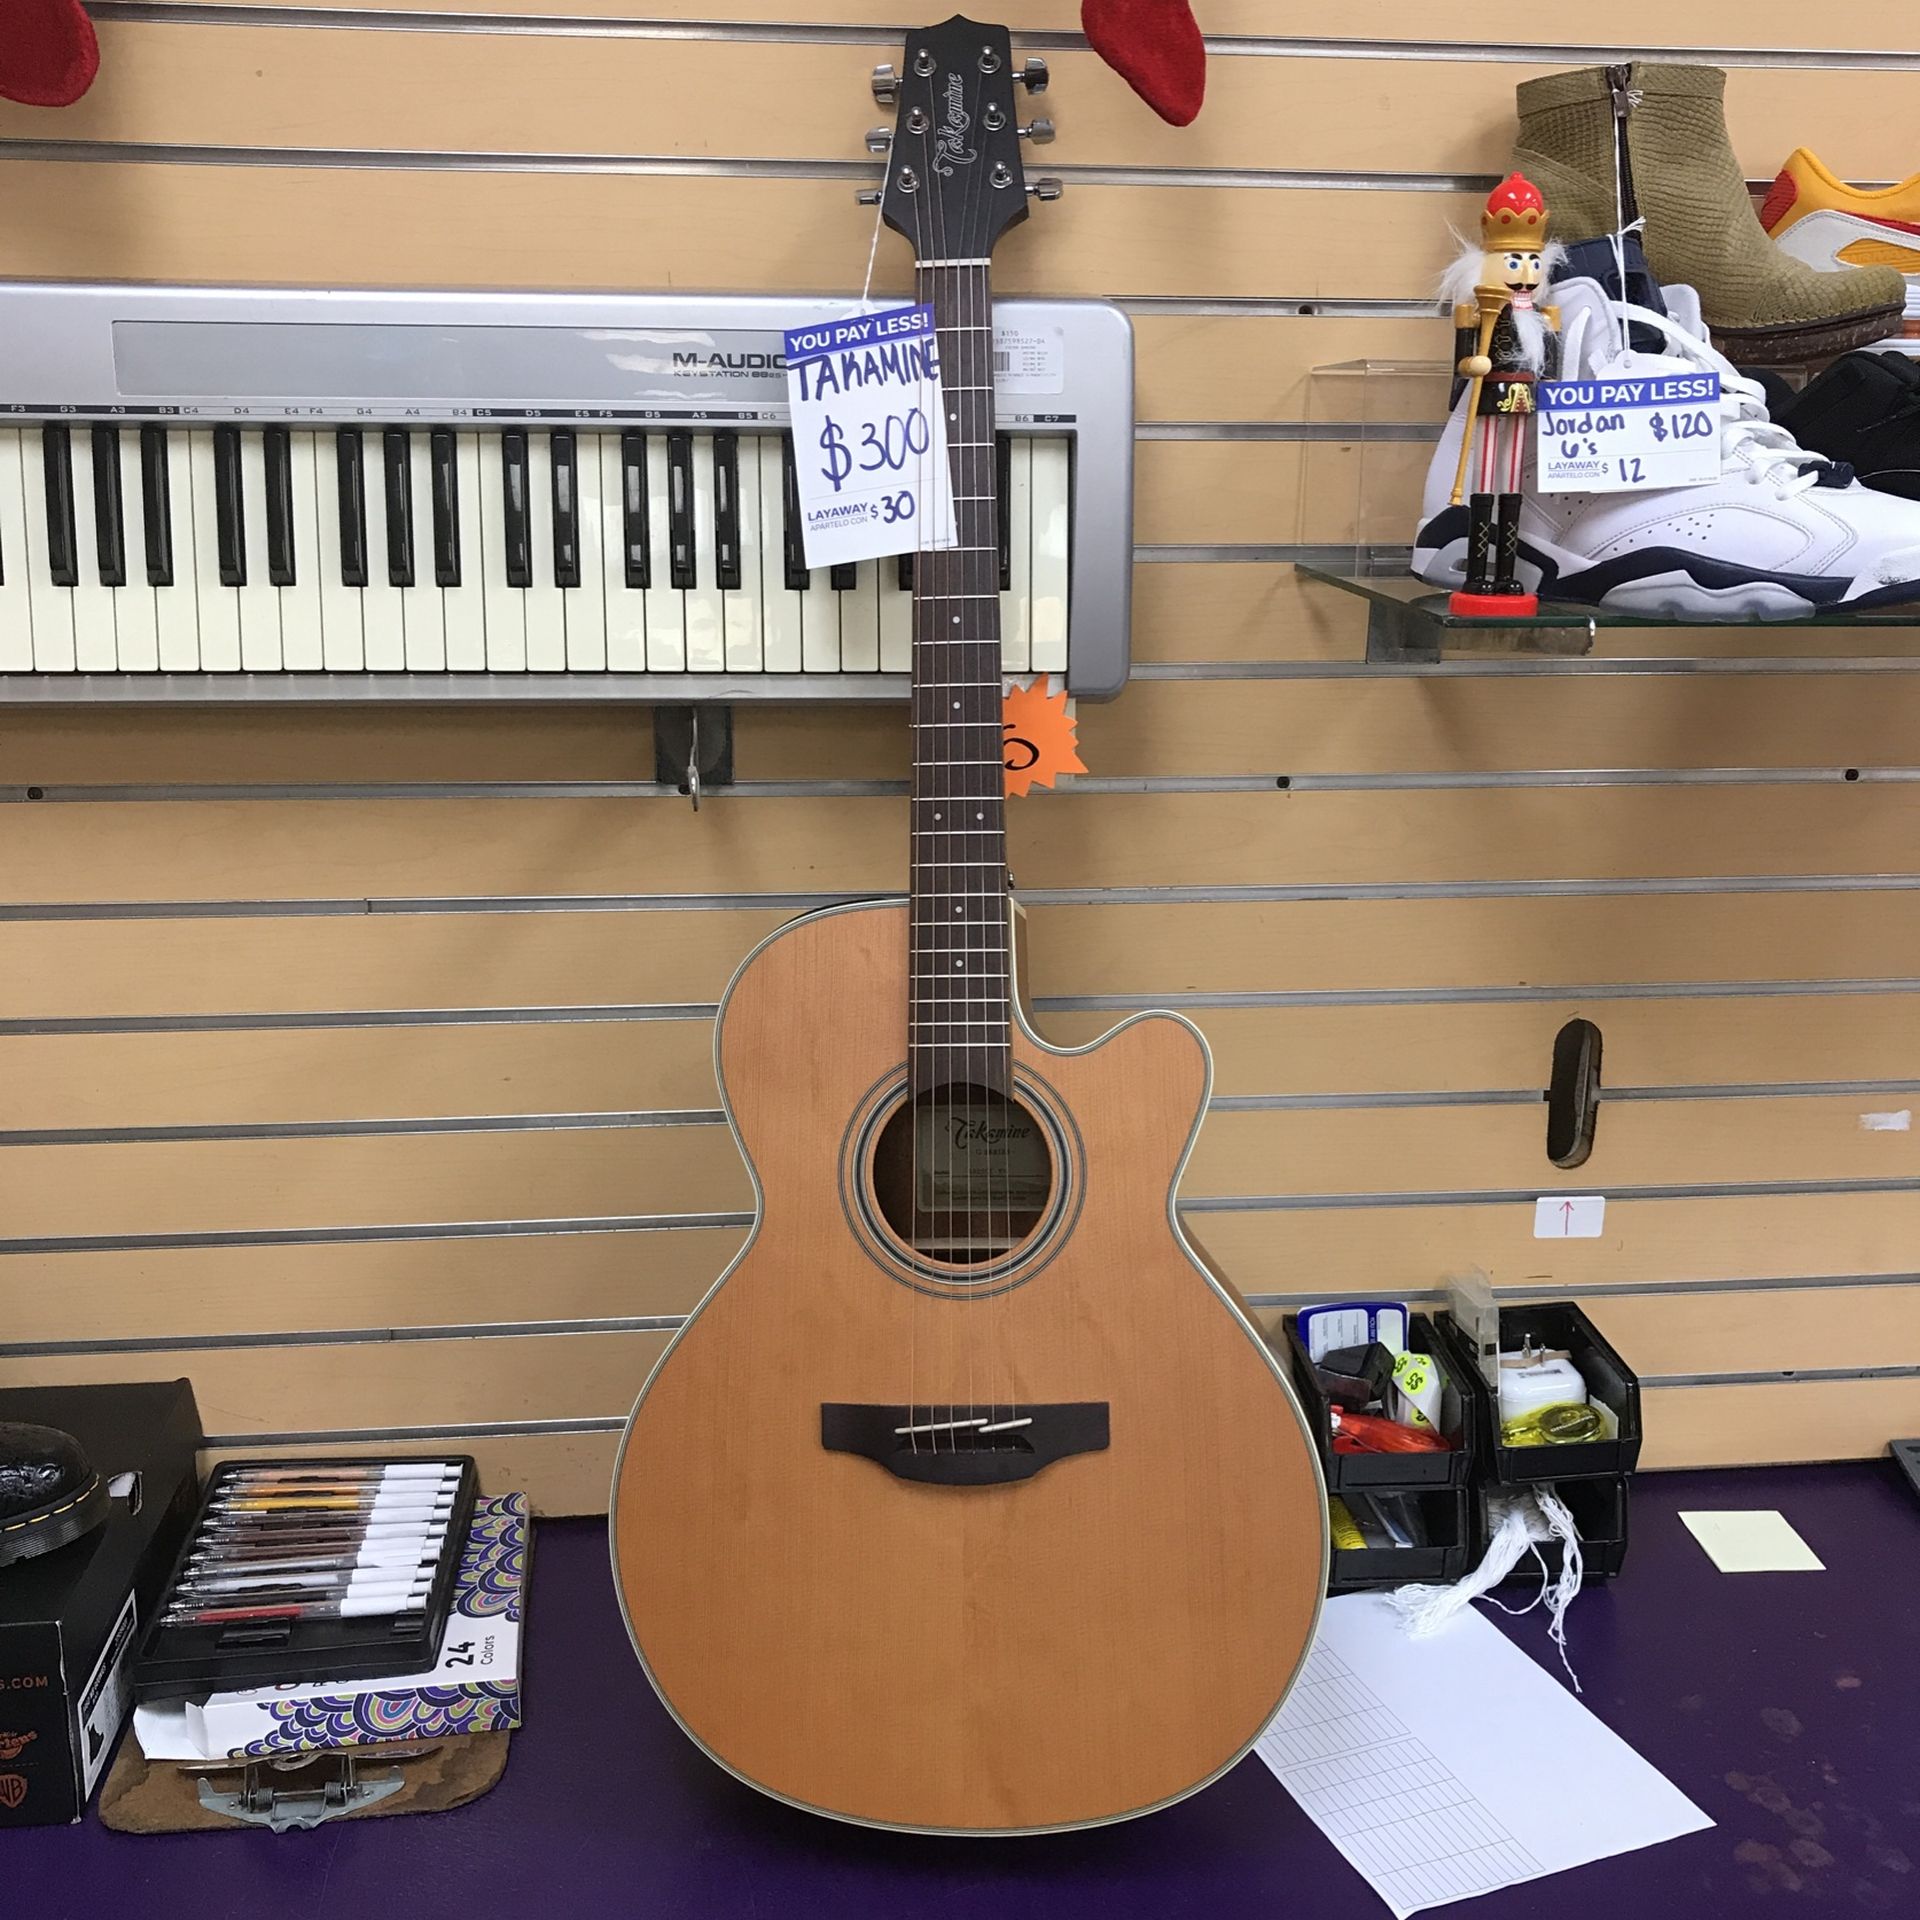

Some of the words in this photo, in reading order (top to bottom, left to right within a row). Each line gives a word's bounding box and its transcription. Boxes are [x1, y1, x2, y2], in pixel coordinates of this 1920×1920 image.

[932, 72, 977, 177] Takamine
[790, 330, 831, 353] YOU
[835, 323, 871, 344] PAY
[876, 312, 929, 337] LESS!
[787, 338, 940, 402] TAKAMINE
[1545, 387, 1594, 405] YOU
[1601, 383, 1645, 404] PAY
[1651, 378, 1714, 401] LESS!
[10, 405, 26, 413] F3
[60, 405, 77, 413] G3
[110, 406, 126, 414] A3
[158, 406, 174, 414] B3
[284, 407, 299, 415] E4
[309, 407, 323, 415] F4
[356, 407, 372, 415] G4
[525, 409, 541, 417] D5
[599, 410, 614, 418] F5
[692, 411, 708, 419] A5
[1542, 411, 1625, 436] Jordan
[1649, 410, 1714, 442] $120
[819, 408, 929, 492] $300
[1547, 460, 1600, 470] LAYAWAY
[807, 502, 868, 521] LAYAWAY
[850, 516, 868, 526] CON
[944, 1117, 1031, 1149] Takamine
[445, 1641, 475, 1669] 24
[480, 1635, 495, 1665] Colors
